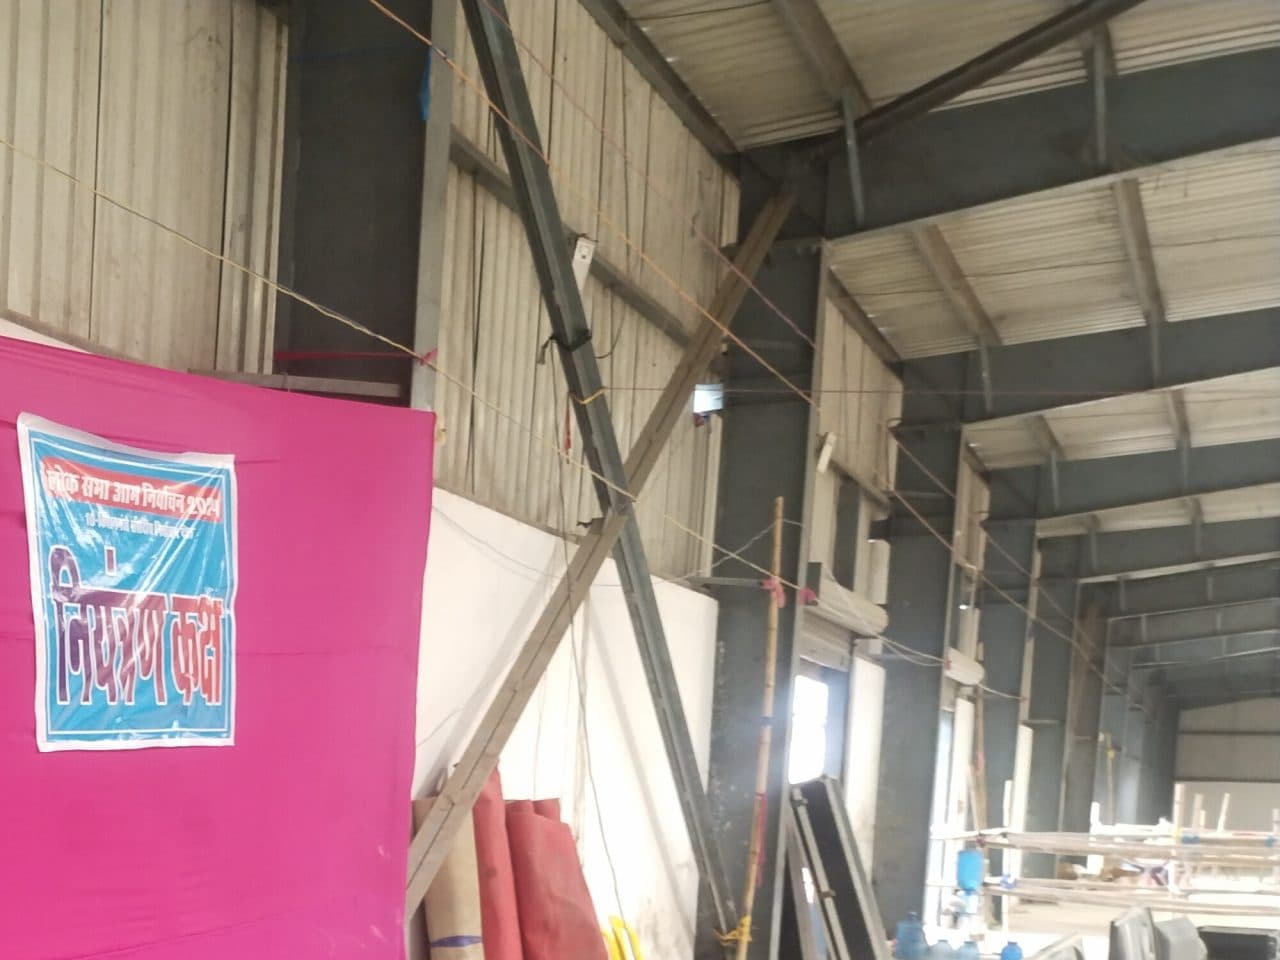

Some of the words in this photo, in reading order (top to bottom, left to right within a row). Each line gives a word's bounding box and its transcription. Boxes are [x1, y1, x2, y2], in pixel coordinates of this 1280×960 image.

[45, 465, 81, 496] लोक
[81, 475, 110, 500] सभा
[113, 481, 140, 506] आम
[48, 544, 169, 706] नियंत्रण
[170, 592, 225, 706] कक्ष
